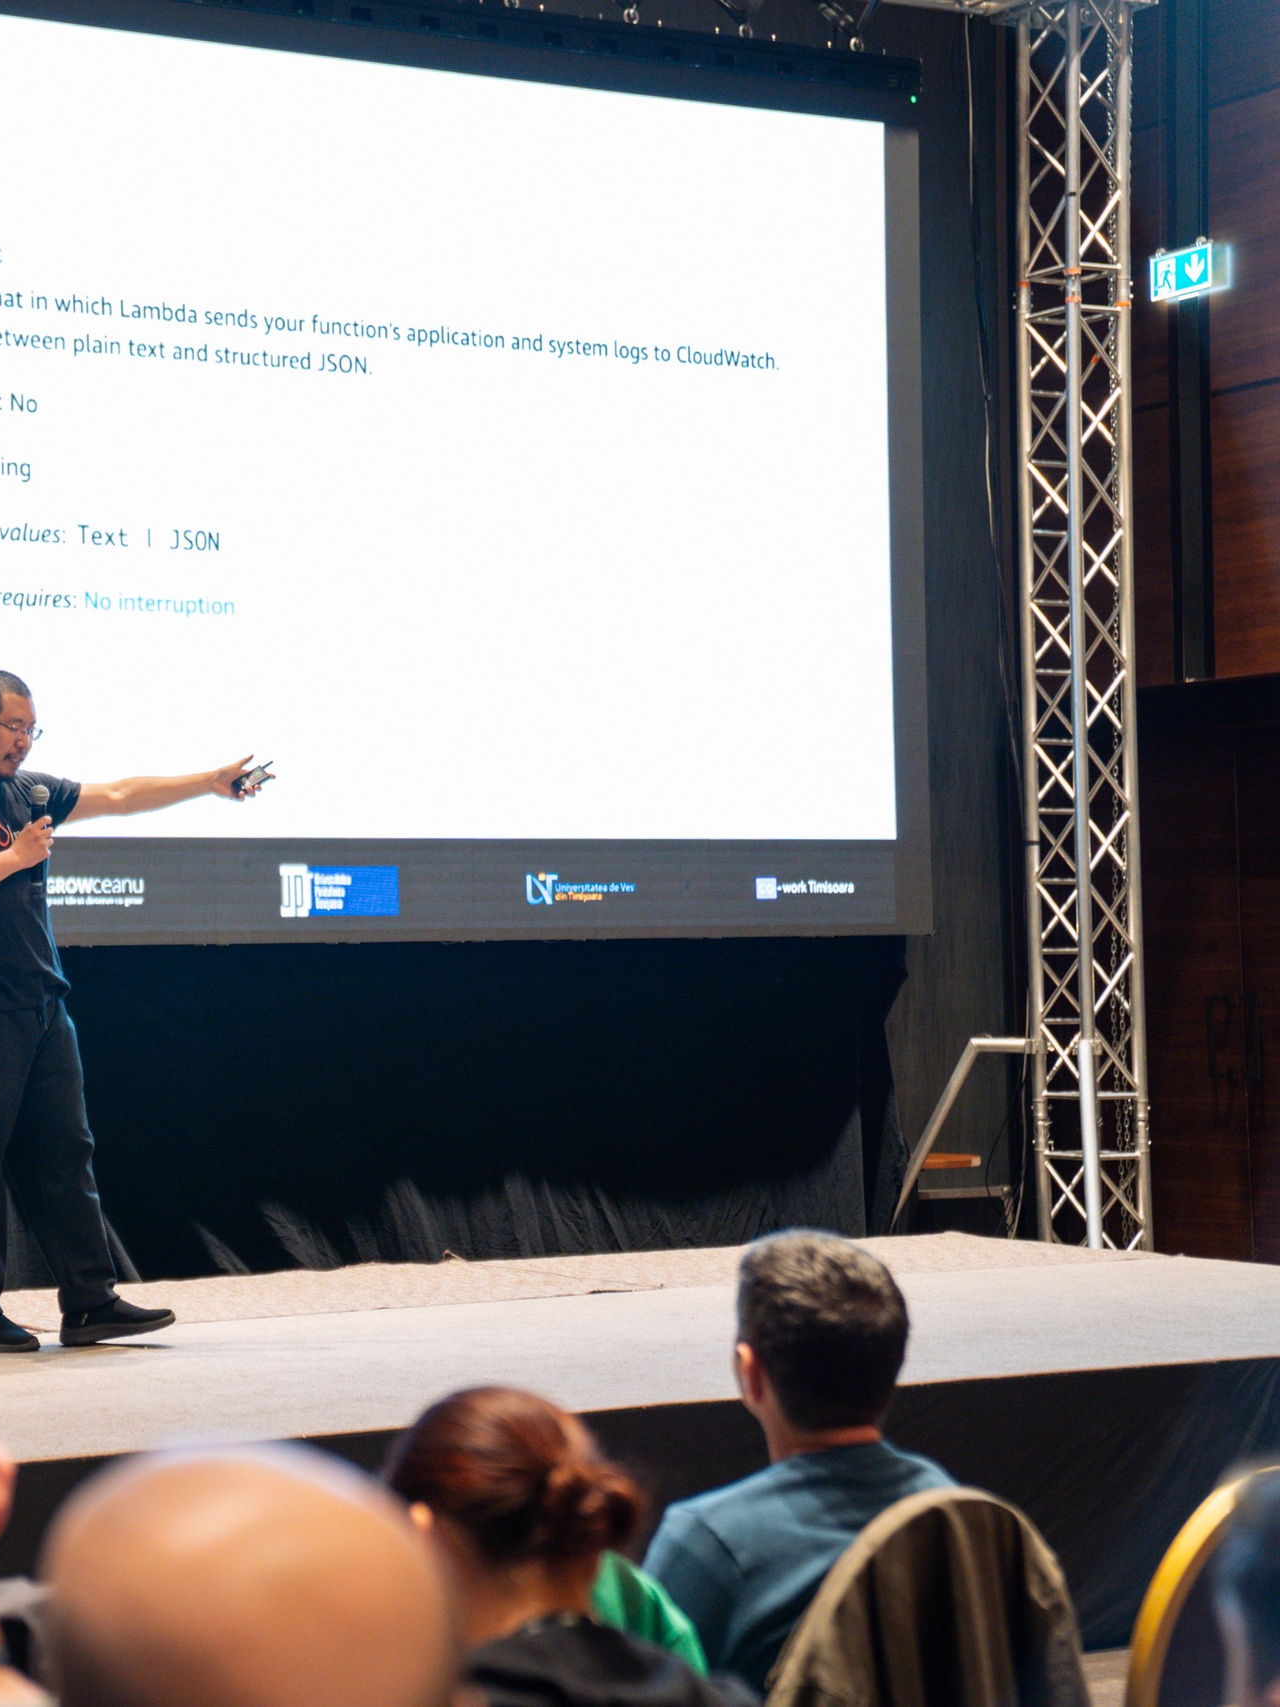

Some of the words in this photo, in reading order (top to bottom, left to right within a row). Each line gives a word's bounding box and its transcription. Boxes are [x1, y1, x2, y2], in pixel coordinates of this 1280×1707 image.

[30, 290, 48, 311] in
[54, 293, 113, 316] which
[119, 299, 198, 324] Lambda
[204, 308, 259, 329] sends
[263, 315, 306, 336] your
[311, 313, 401, 341] function's
[406, 325, 505, 349] application
[511, 333, 543, 353] and
[548, 339, 609, 359] system
[613, 339, 649, 366] logs
[653, 345, 671, 363] to
[676, 345, 780, 370] CloudWatch.
[73, 333, 121, 357] plain
[128, 339, 166, 359] text
[172, 343, 208, 363] and
[214, 347, 312, 371] structured
[317, 353, 373, 375] JSON.
[10, 392, 38, 414] No
[0, 522, 67, 544] values:
[76, 524, 129, 548] Text
[169, 529, 220, 552] JSON
[84, 591, 112, 610] No
[118, 595, 235, 617] interruption
[609, 883, 619, 892] de
[620, 883, 636, 892] Ves
